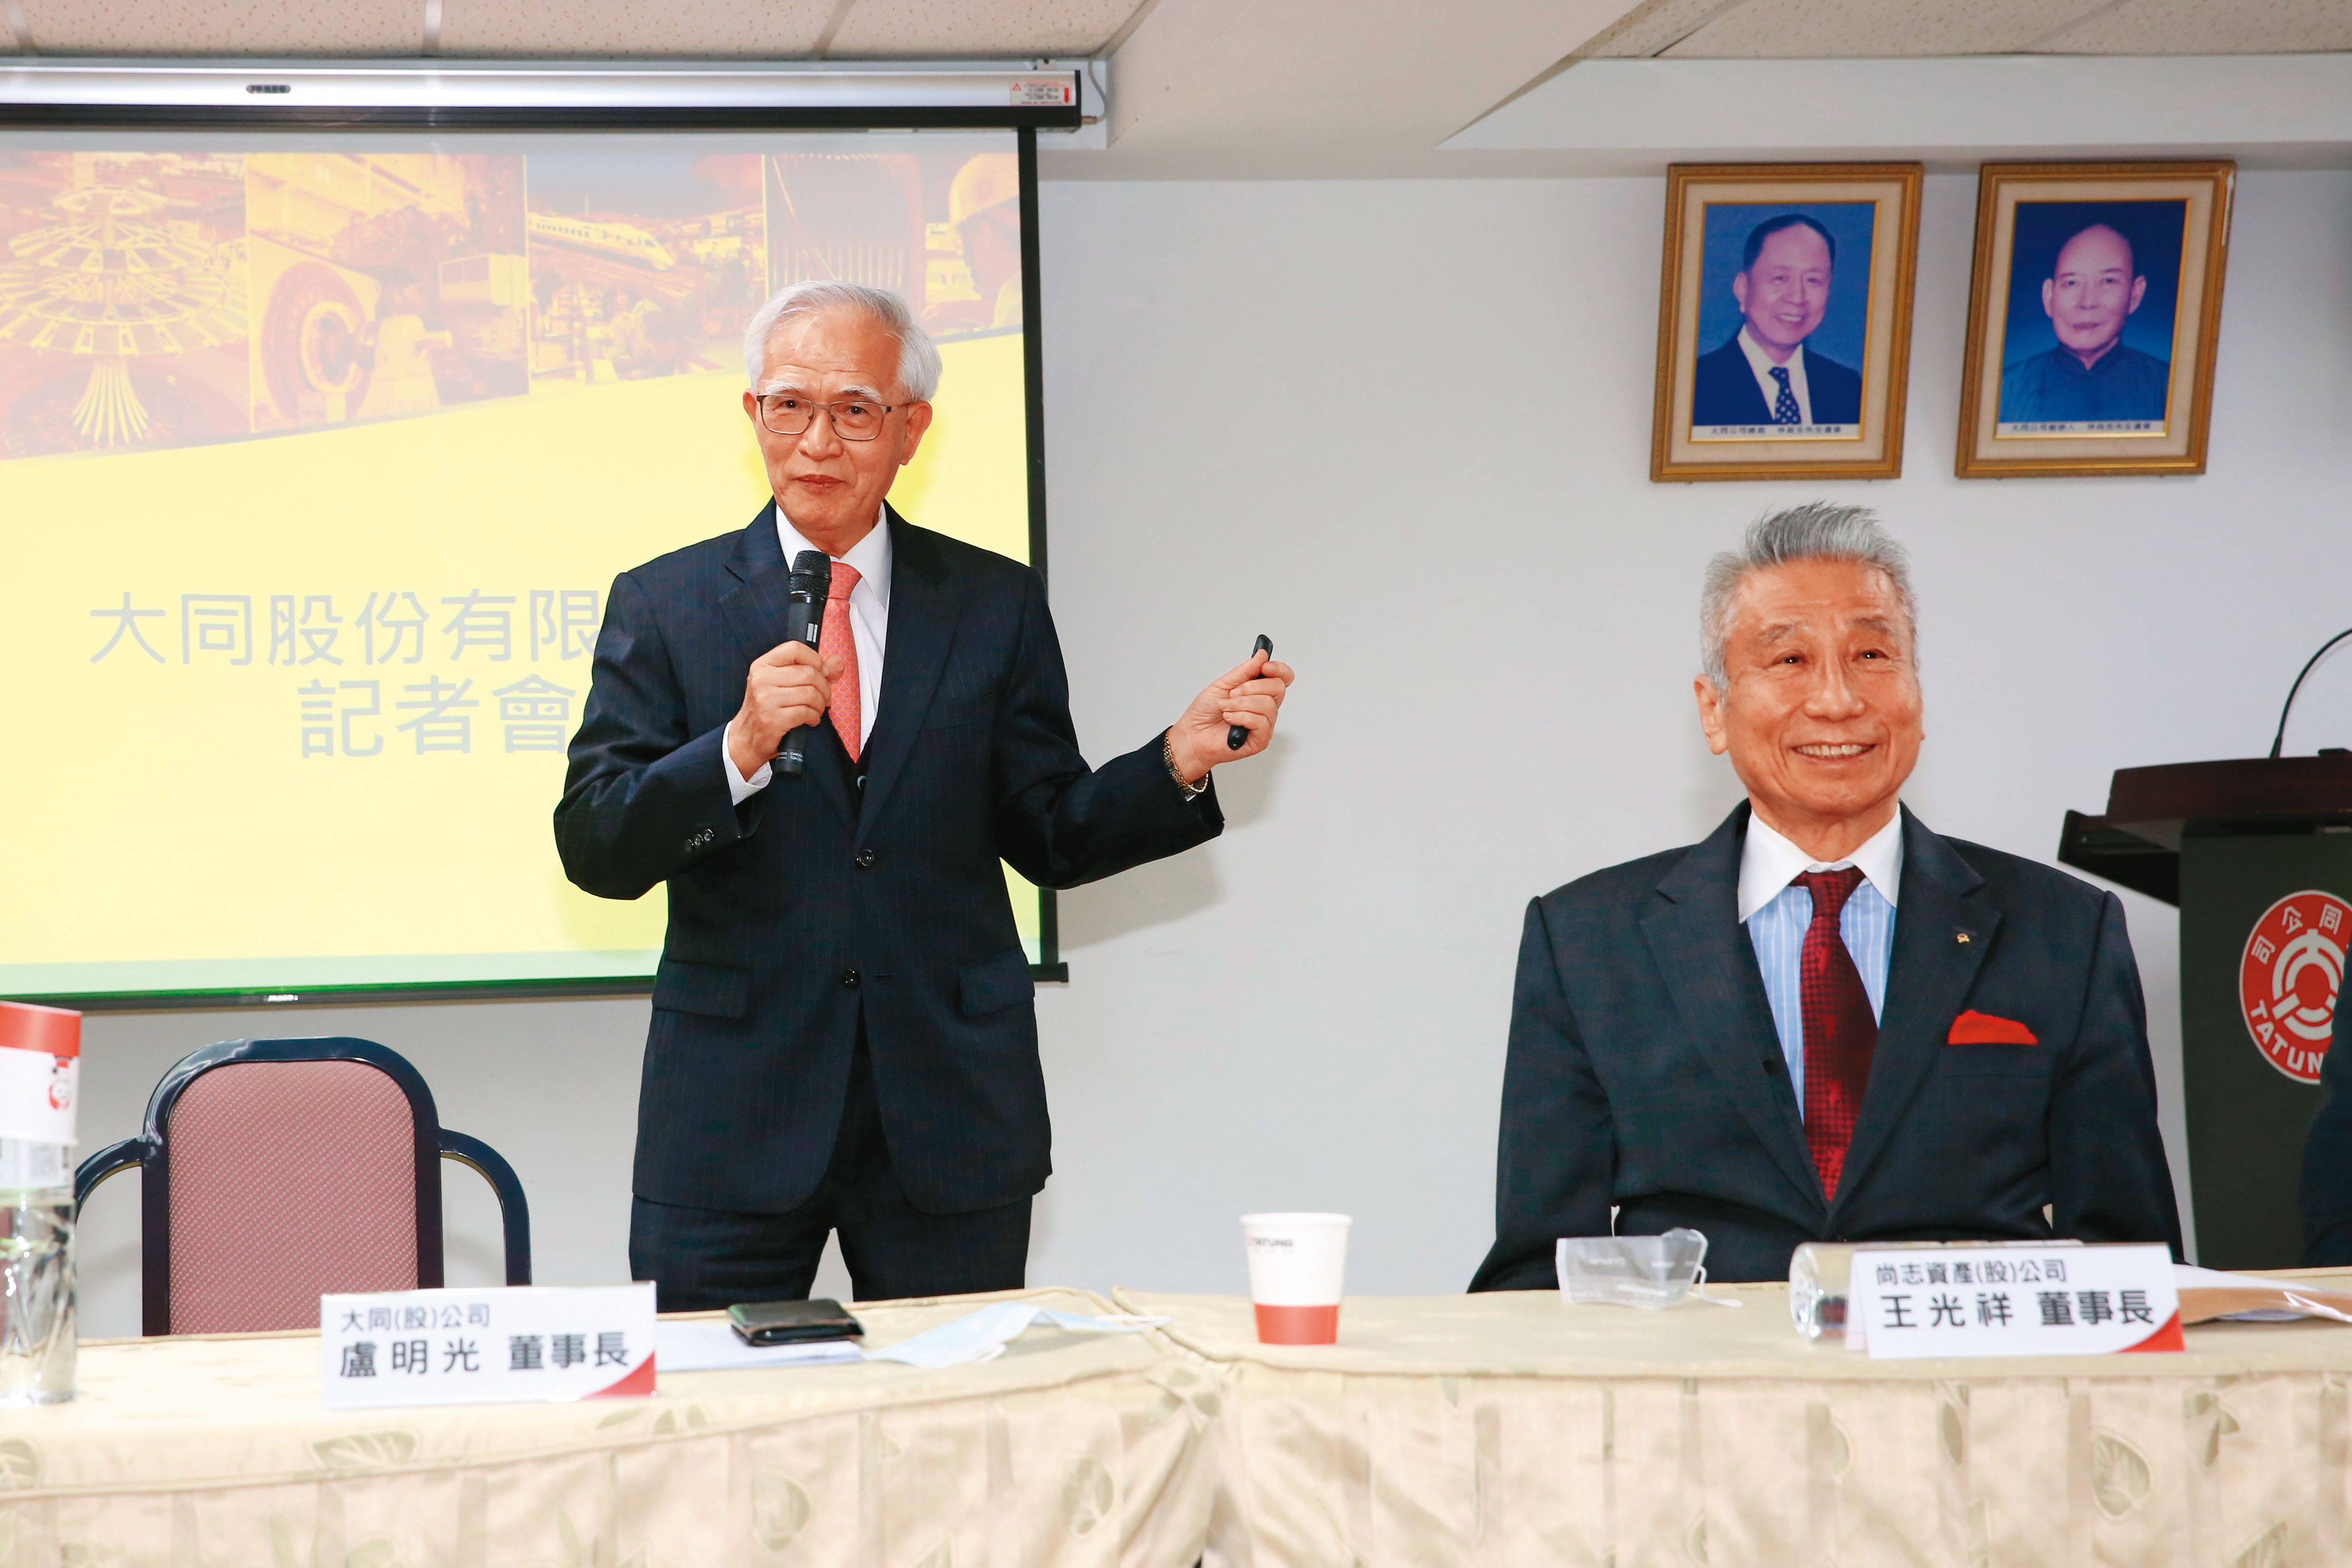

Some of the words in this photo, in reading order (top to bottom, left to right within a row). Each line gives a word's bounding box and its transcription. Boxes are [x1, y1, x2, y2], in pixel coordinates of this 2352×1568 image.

[89, 588, 601, 666] 大同股份有限
[297, 673, 576, 759] 記者會
[2250, 999, 2324, 1074] TATUN
[1876, 1259, 2066, 1286] 尚志資產(股)公司
[341, 1304, 490, 1332] 大同(股)公司
[1880, 1293, 2013, 1328] 王光祥
[2037, 1290, 2155, 1326] 董事長
[340, 1337, 480, 1378] 盧明光
[508, 1331, 629, 1371] 董事長
